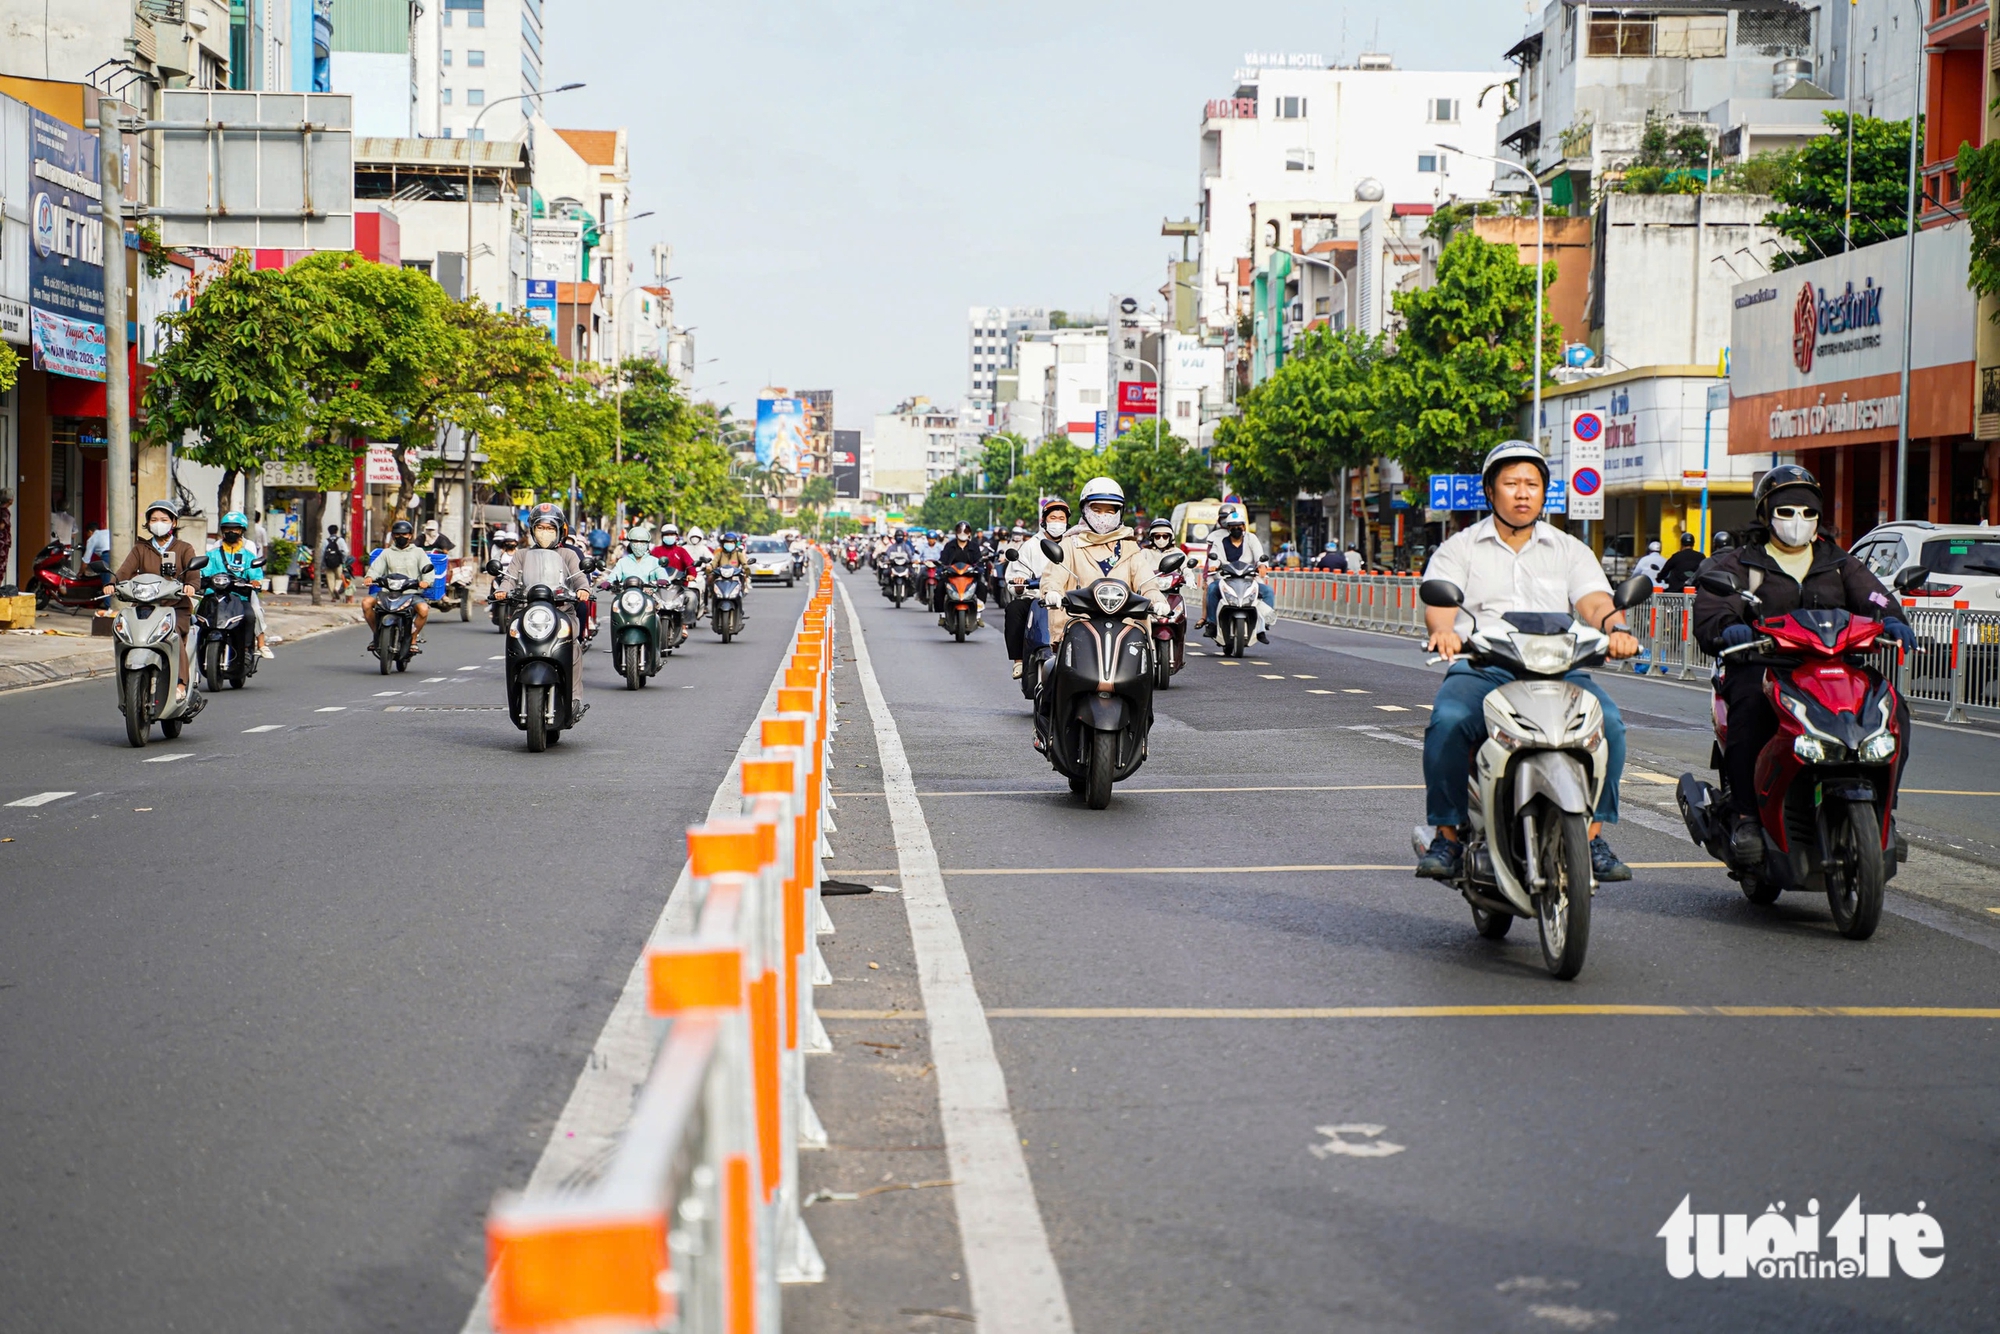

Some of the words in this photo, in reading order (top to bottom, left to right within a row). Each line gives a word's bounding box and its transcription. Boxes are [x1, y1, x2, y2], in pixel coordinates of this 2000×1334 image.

[1288, 52, 1324, 67] HOTEL
[1206, 97, 1258, 119] HOTEL
[1818, 276, 1882, 336] bestmix
